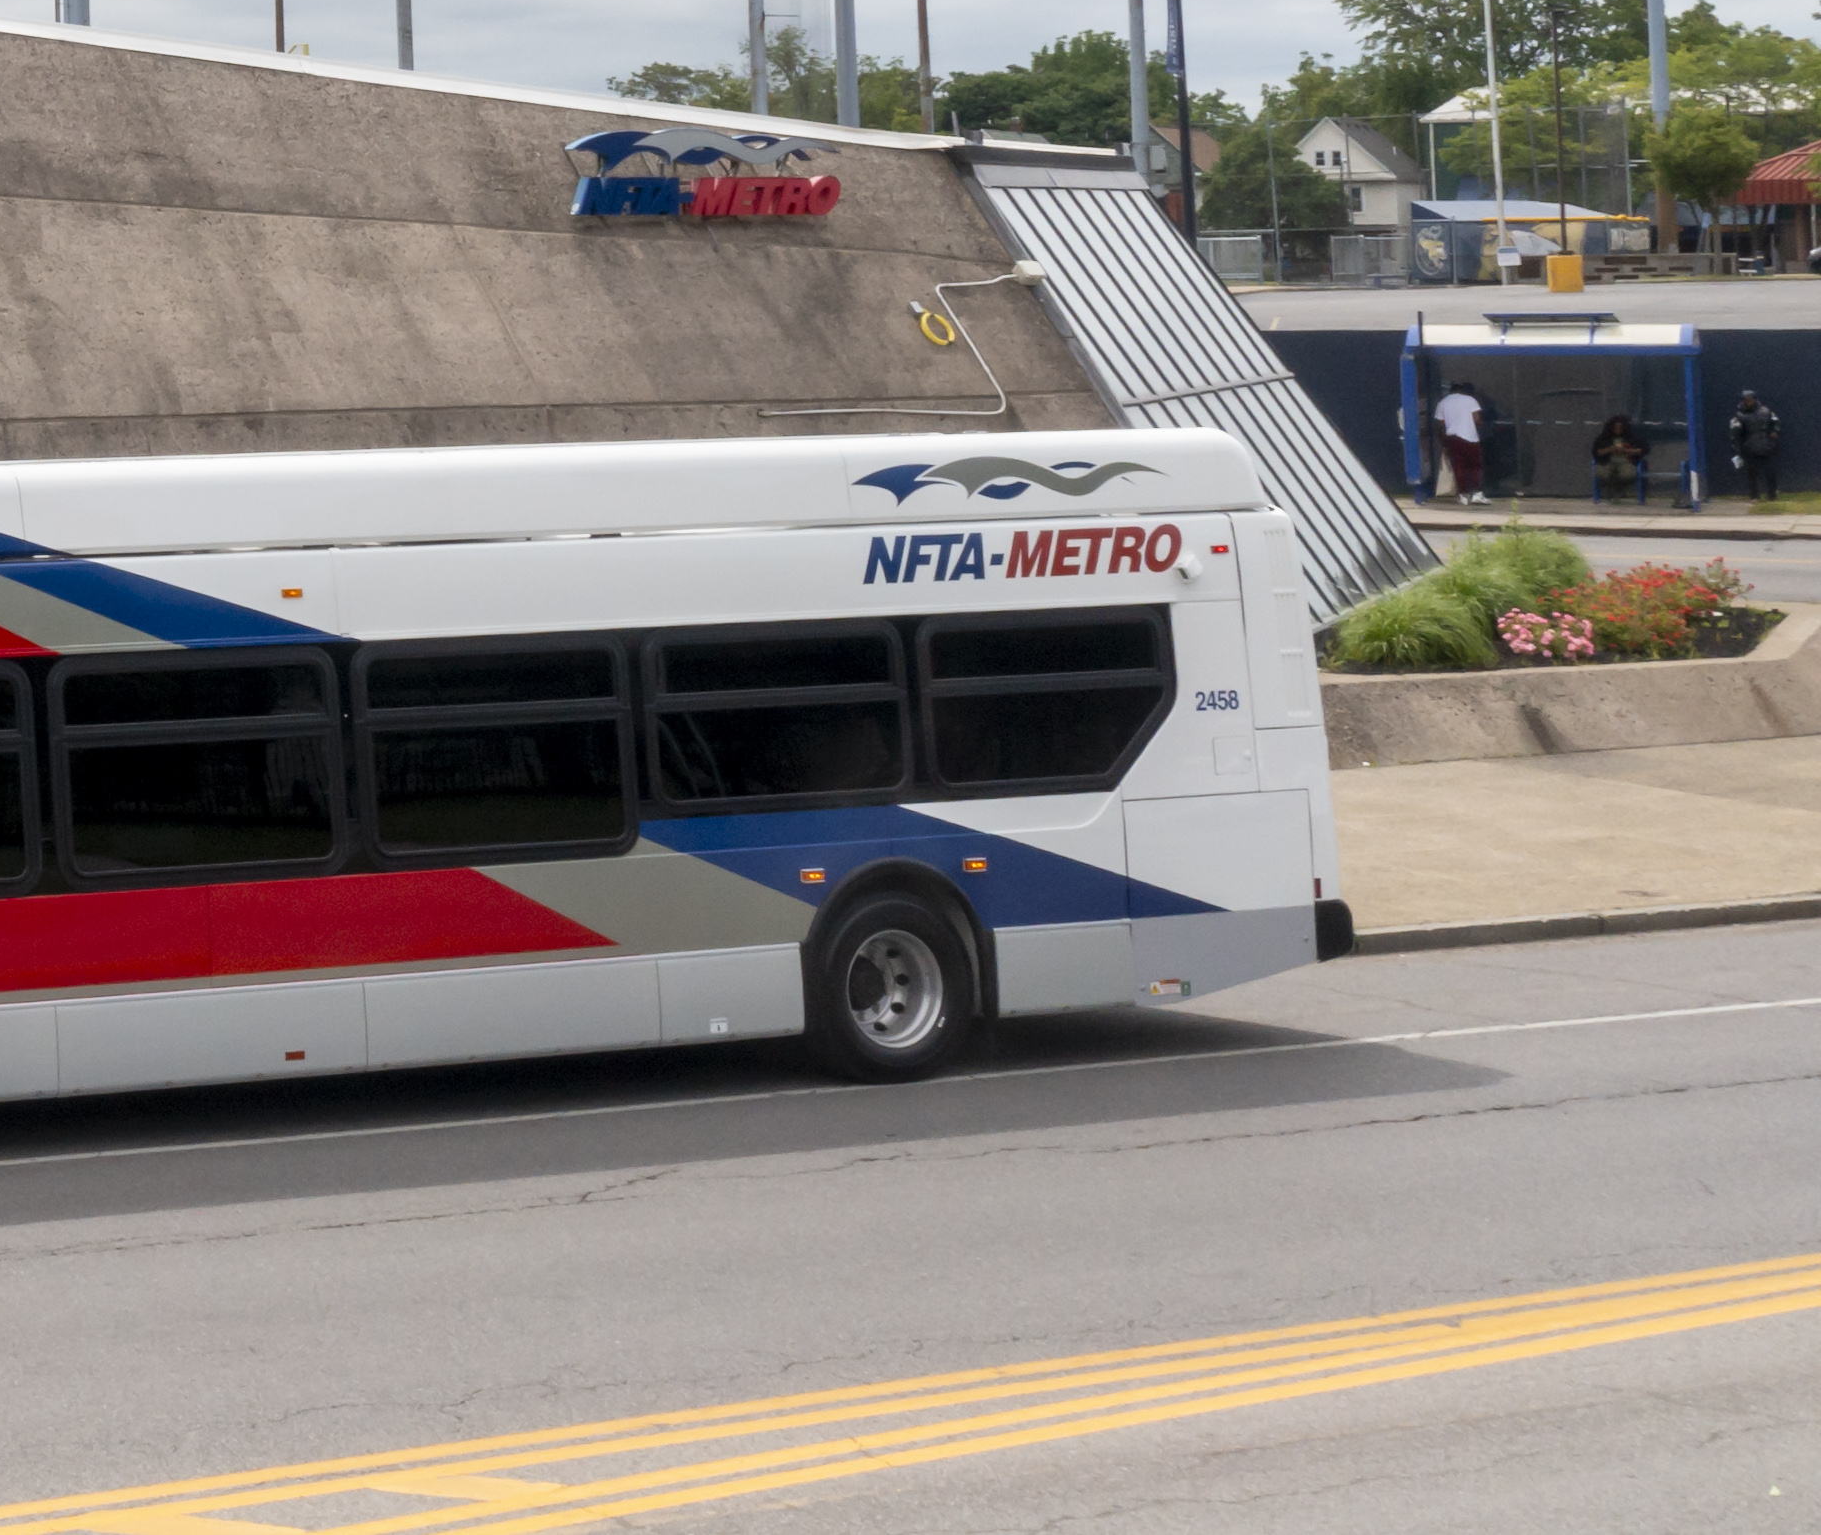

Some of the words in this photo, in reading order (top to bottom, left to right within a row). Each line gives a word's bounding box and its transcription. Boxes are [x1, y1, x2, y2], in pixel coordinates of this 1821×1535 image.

[570, 175, 841, 216] NFTA-METRO
[862, 523, 1183, 585] NFTA-METRO
[1195, 690, 1239, 711] 2458
